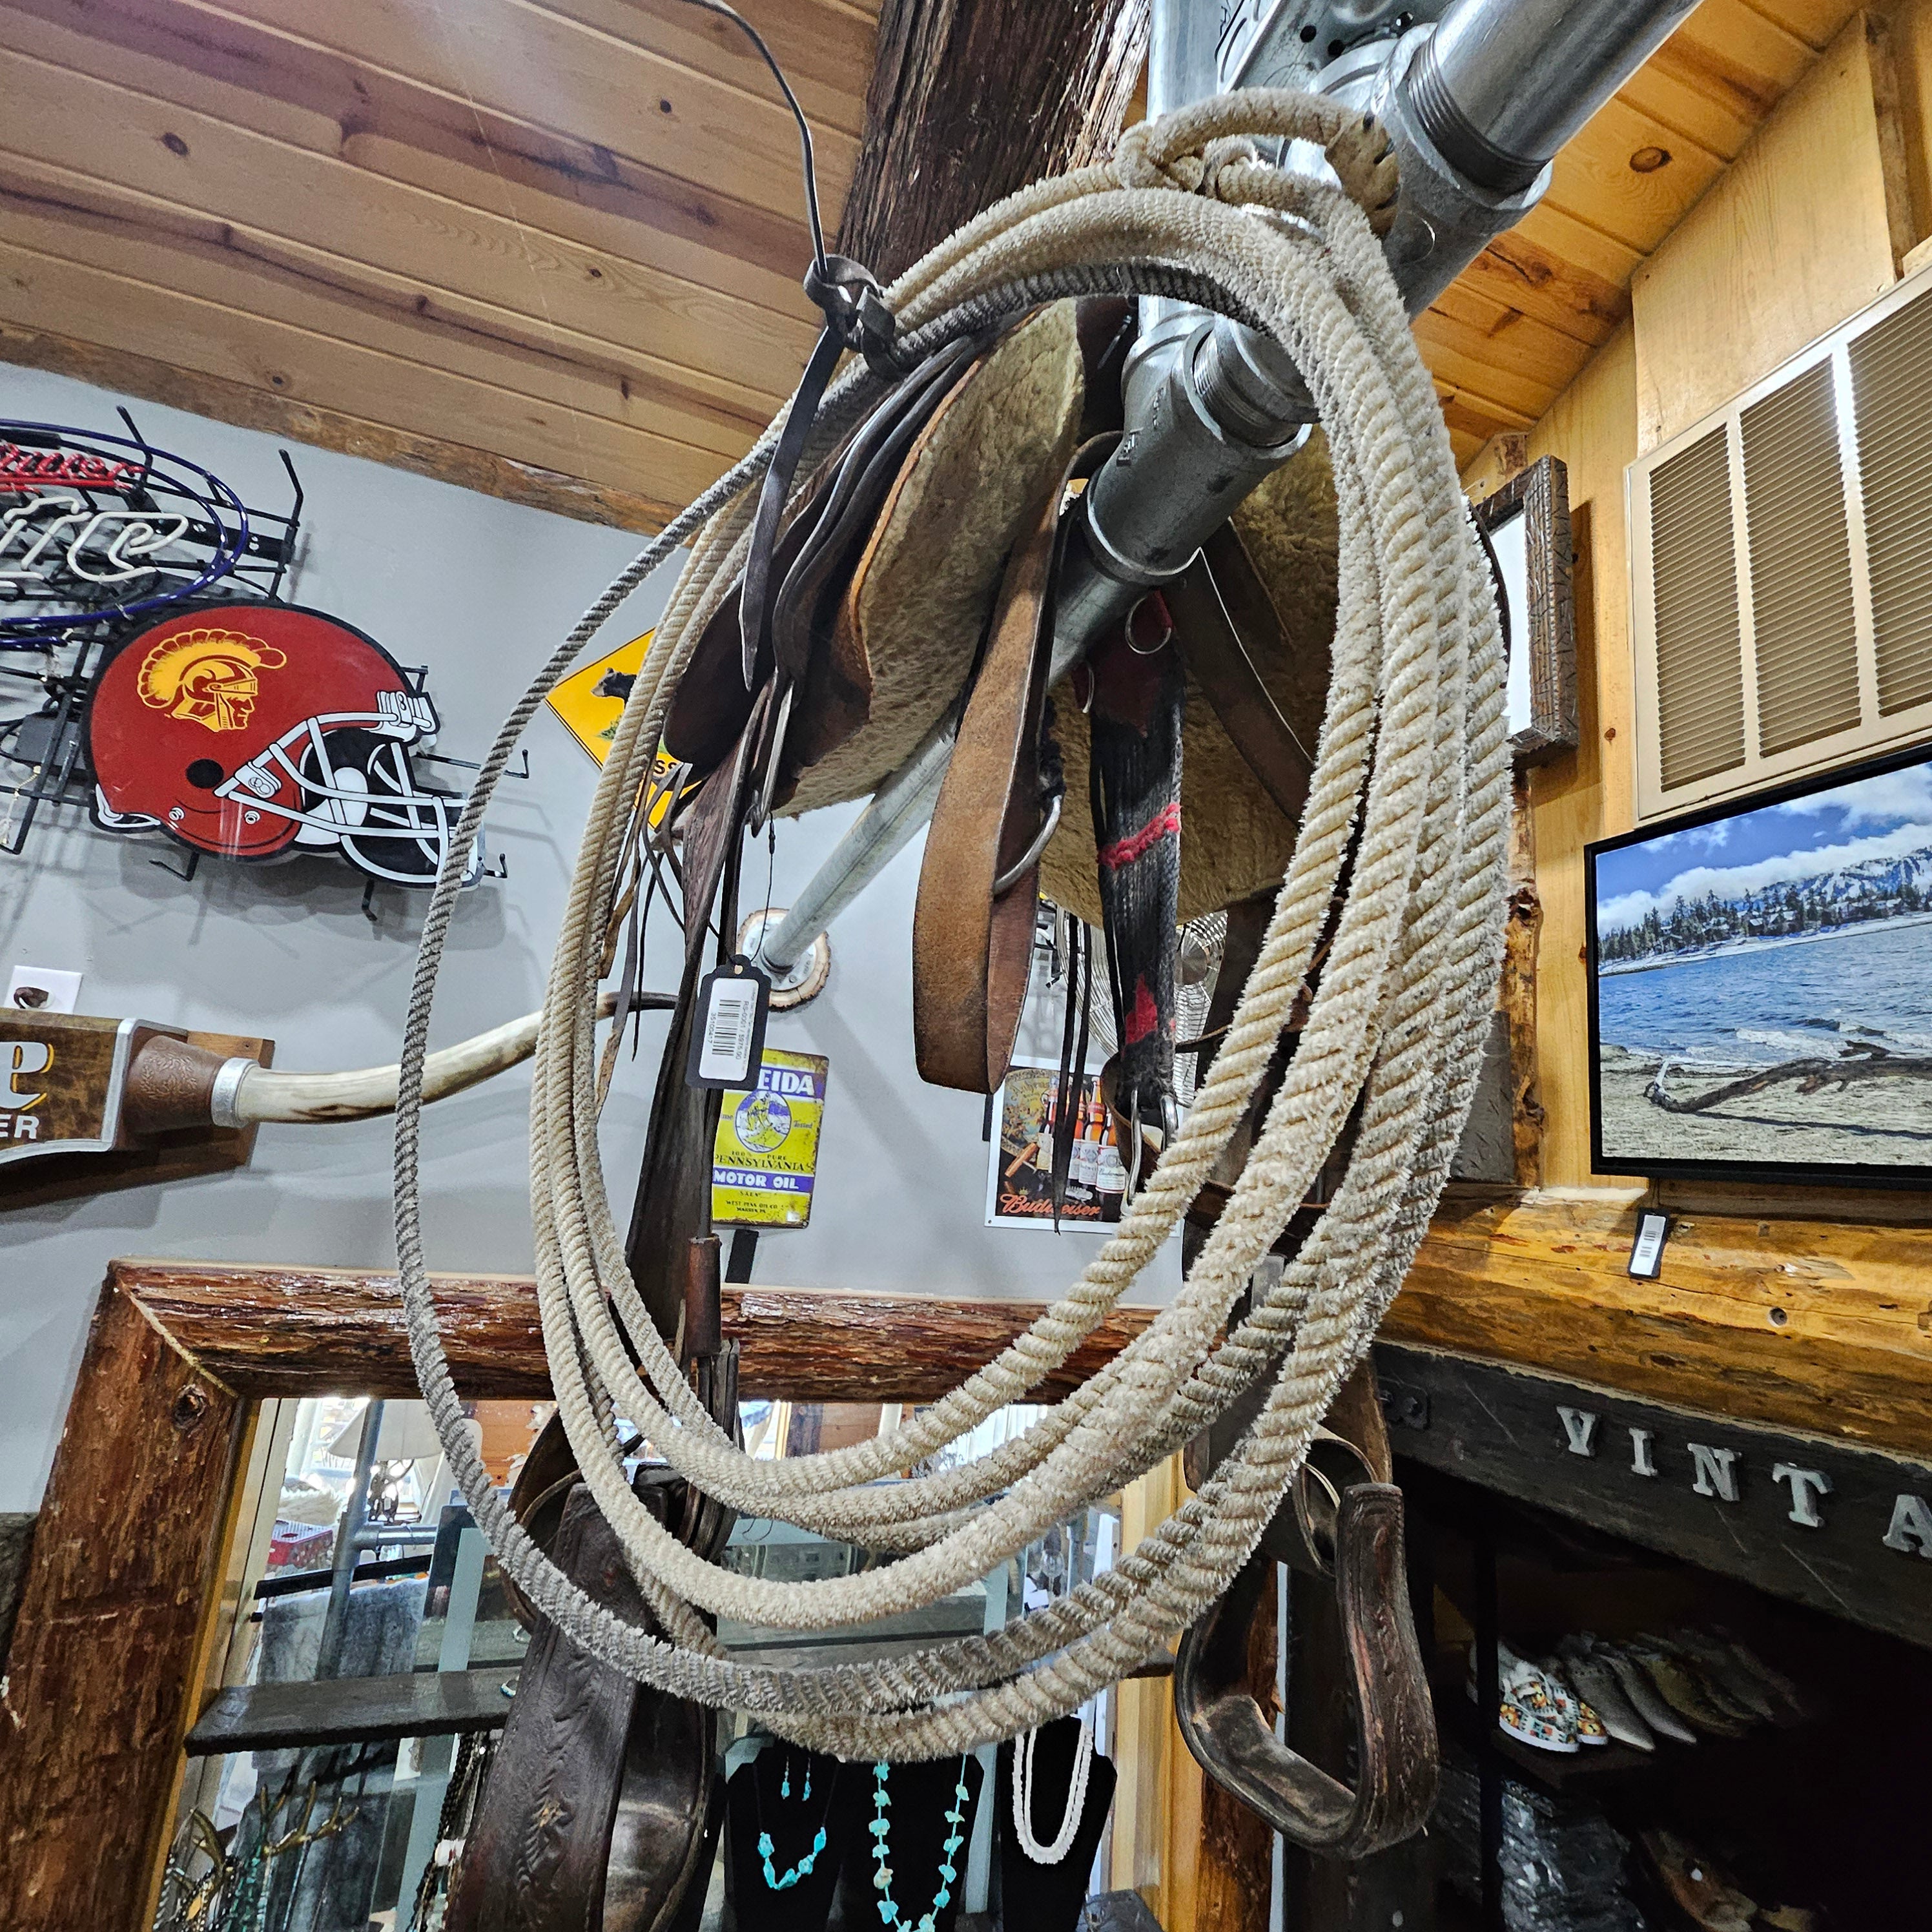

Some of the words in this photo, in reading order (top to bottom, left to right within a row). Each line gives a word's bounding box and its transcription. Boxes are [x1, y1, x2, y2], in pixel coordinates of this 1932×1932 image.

[713, 1169, 767, 1187] MOTOR
[773, 1177, 799, 1189] OIL
[1000, 1194, 1101, 1216] Budeiser
